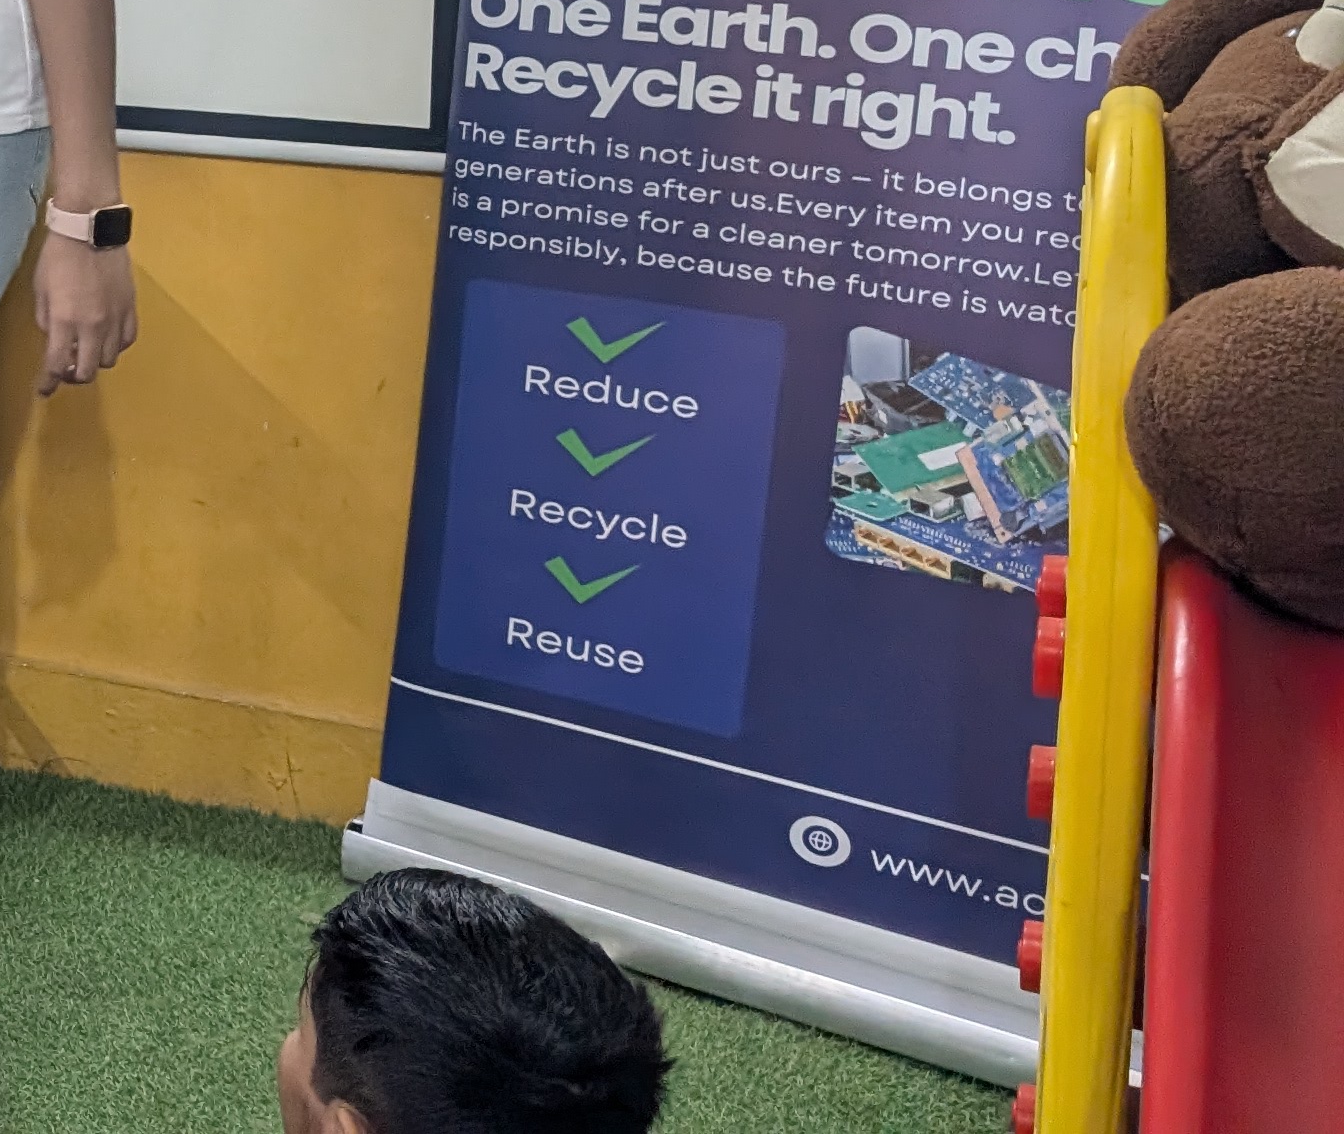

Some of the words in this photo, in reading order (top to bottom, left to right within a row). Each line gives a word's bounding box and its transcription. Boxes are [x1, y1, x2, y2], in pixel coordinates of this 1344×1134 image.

[850, 13, 1015, 74] One
[1025, 27, 1122, 82] ch
[464, 42, 742, 118] Recycle
[752, 64, 802, 122] it
[812, 72, 1016, 150] right.
[454, 158, 633, 194] generations
[642, 178, 721, 204] after
[875, 204, 951, 234] item
[962, 220, 1024, 243] you
[1035, 229, 1081, 251] rec
[458, 121, 505, 145] The
[515, 128, 596, 156] Earth
[606, 137, 630, 159] is
[639, 145, 692, 167] not
[697, 148, 760, 174] just
[768, 160, 841, 184] ours
[882, 168, 904, 191] it
[914, 172, 1052, 212] belongs
[448, 224, 627, 266] responsibly,
[637, 245, 772, 283] because
[781, 266, 836, 292] the
[845, 273, 951, 308] future
[962, 289, 987, 314] is
[997, 300, 1077, 327] watc
[452, 187, 469, 208] is
[476, 195, 492, 212] a
[501, 197, 628, 229] promise
[638, 211, 684, 235] for
[692, 222, 709, 239] a
[719, 223, 843, 256] cleaner
[851, 239, 1079, 288] tomorrow.Le
[524, 364, 700, 419] Reduce
[509, 489, 688, 549] Recycle
[506, 617, 645, 674] Reuse
